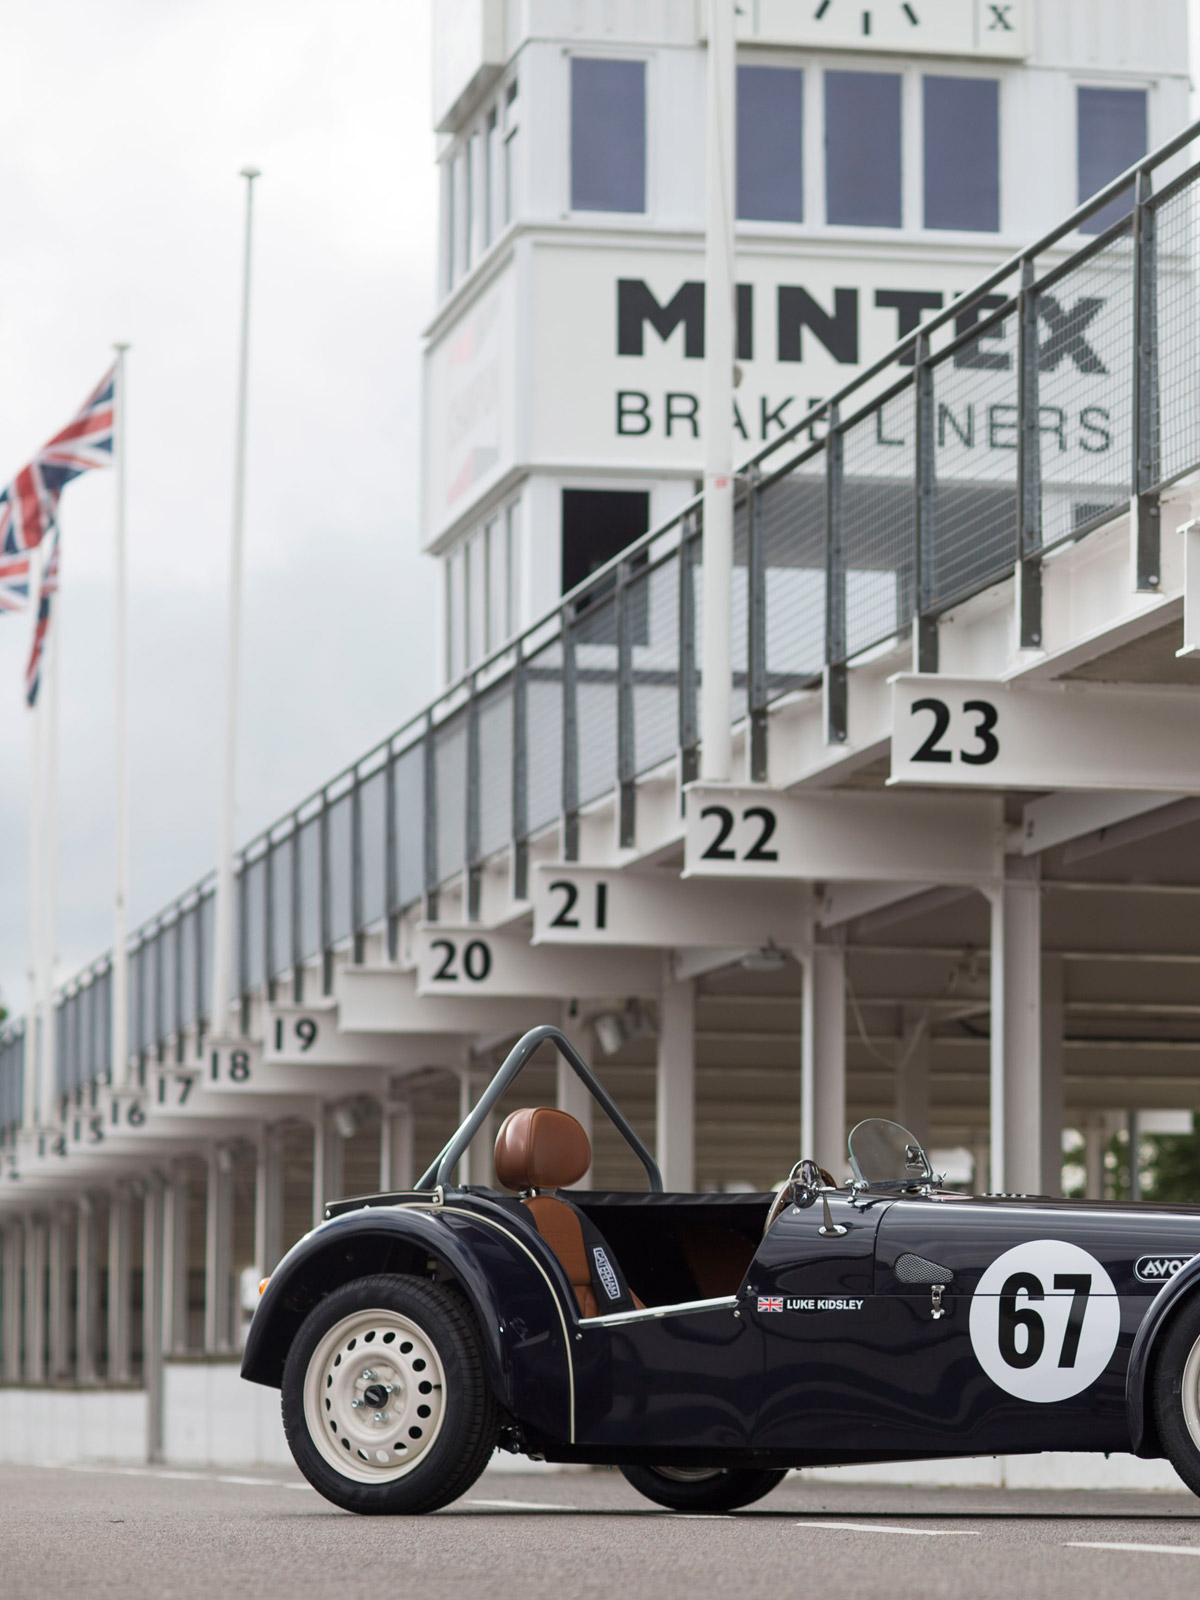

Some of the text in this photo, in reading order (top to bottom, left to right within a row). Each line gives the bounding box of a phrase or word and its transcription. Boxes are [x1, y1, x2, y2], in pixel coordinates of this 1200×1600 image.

[616, 278, 1110, 375] MINTEX
[876, 402, 1112, 454] LNERS
[910, 698, 1001, 765] 23
[700, 805, 779, 862] 22
[548, 880, 608, 929] 21
[430, 939, 492, 982] 20
[275, 1017, 318, 1052] 19
[211, 1051, 250, 1082] 18
[158, 1076, 195, 1105] 17
[74, 1116, 104, 1143] 15
[111, 1099, 146, 1127] 16
[39, 1133, 67, 1157] 14
[594, 1248, 619, 1298] CATERHAM
[1141, 1259, 1188, 1277] AVO
[786, 1299, 864, 1310] LUKE KIDSLEY
[998, 1271, 1092, 1369] 67
